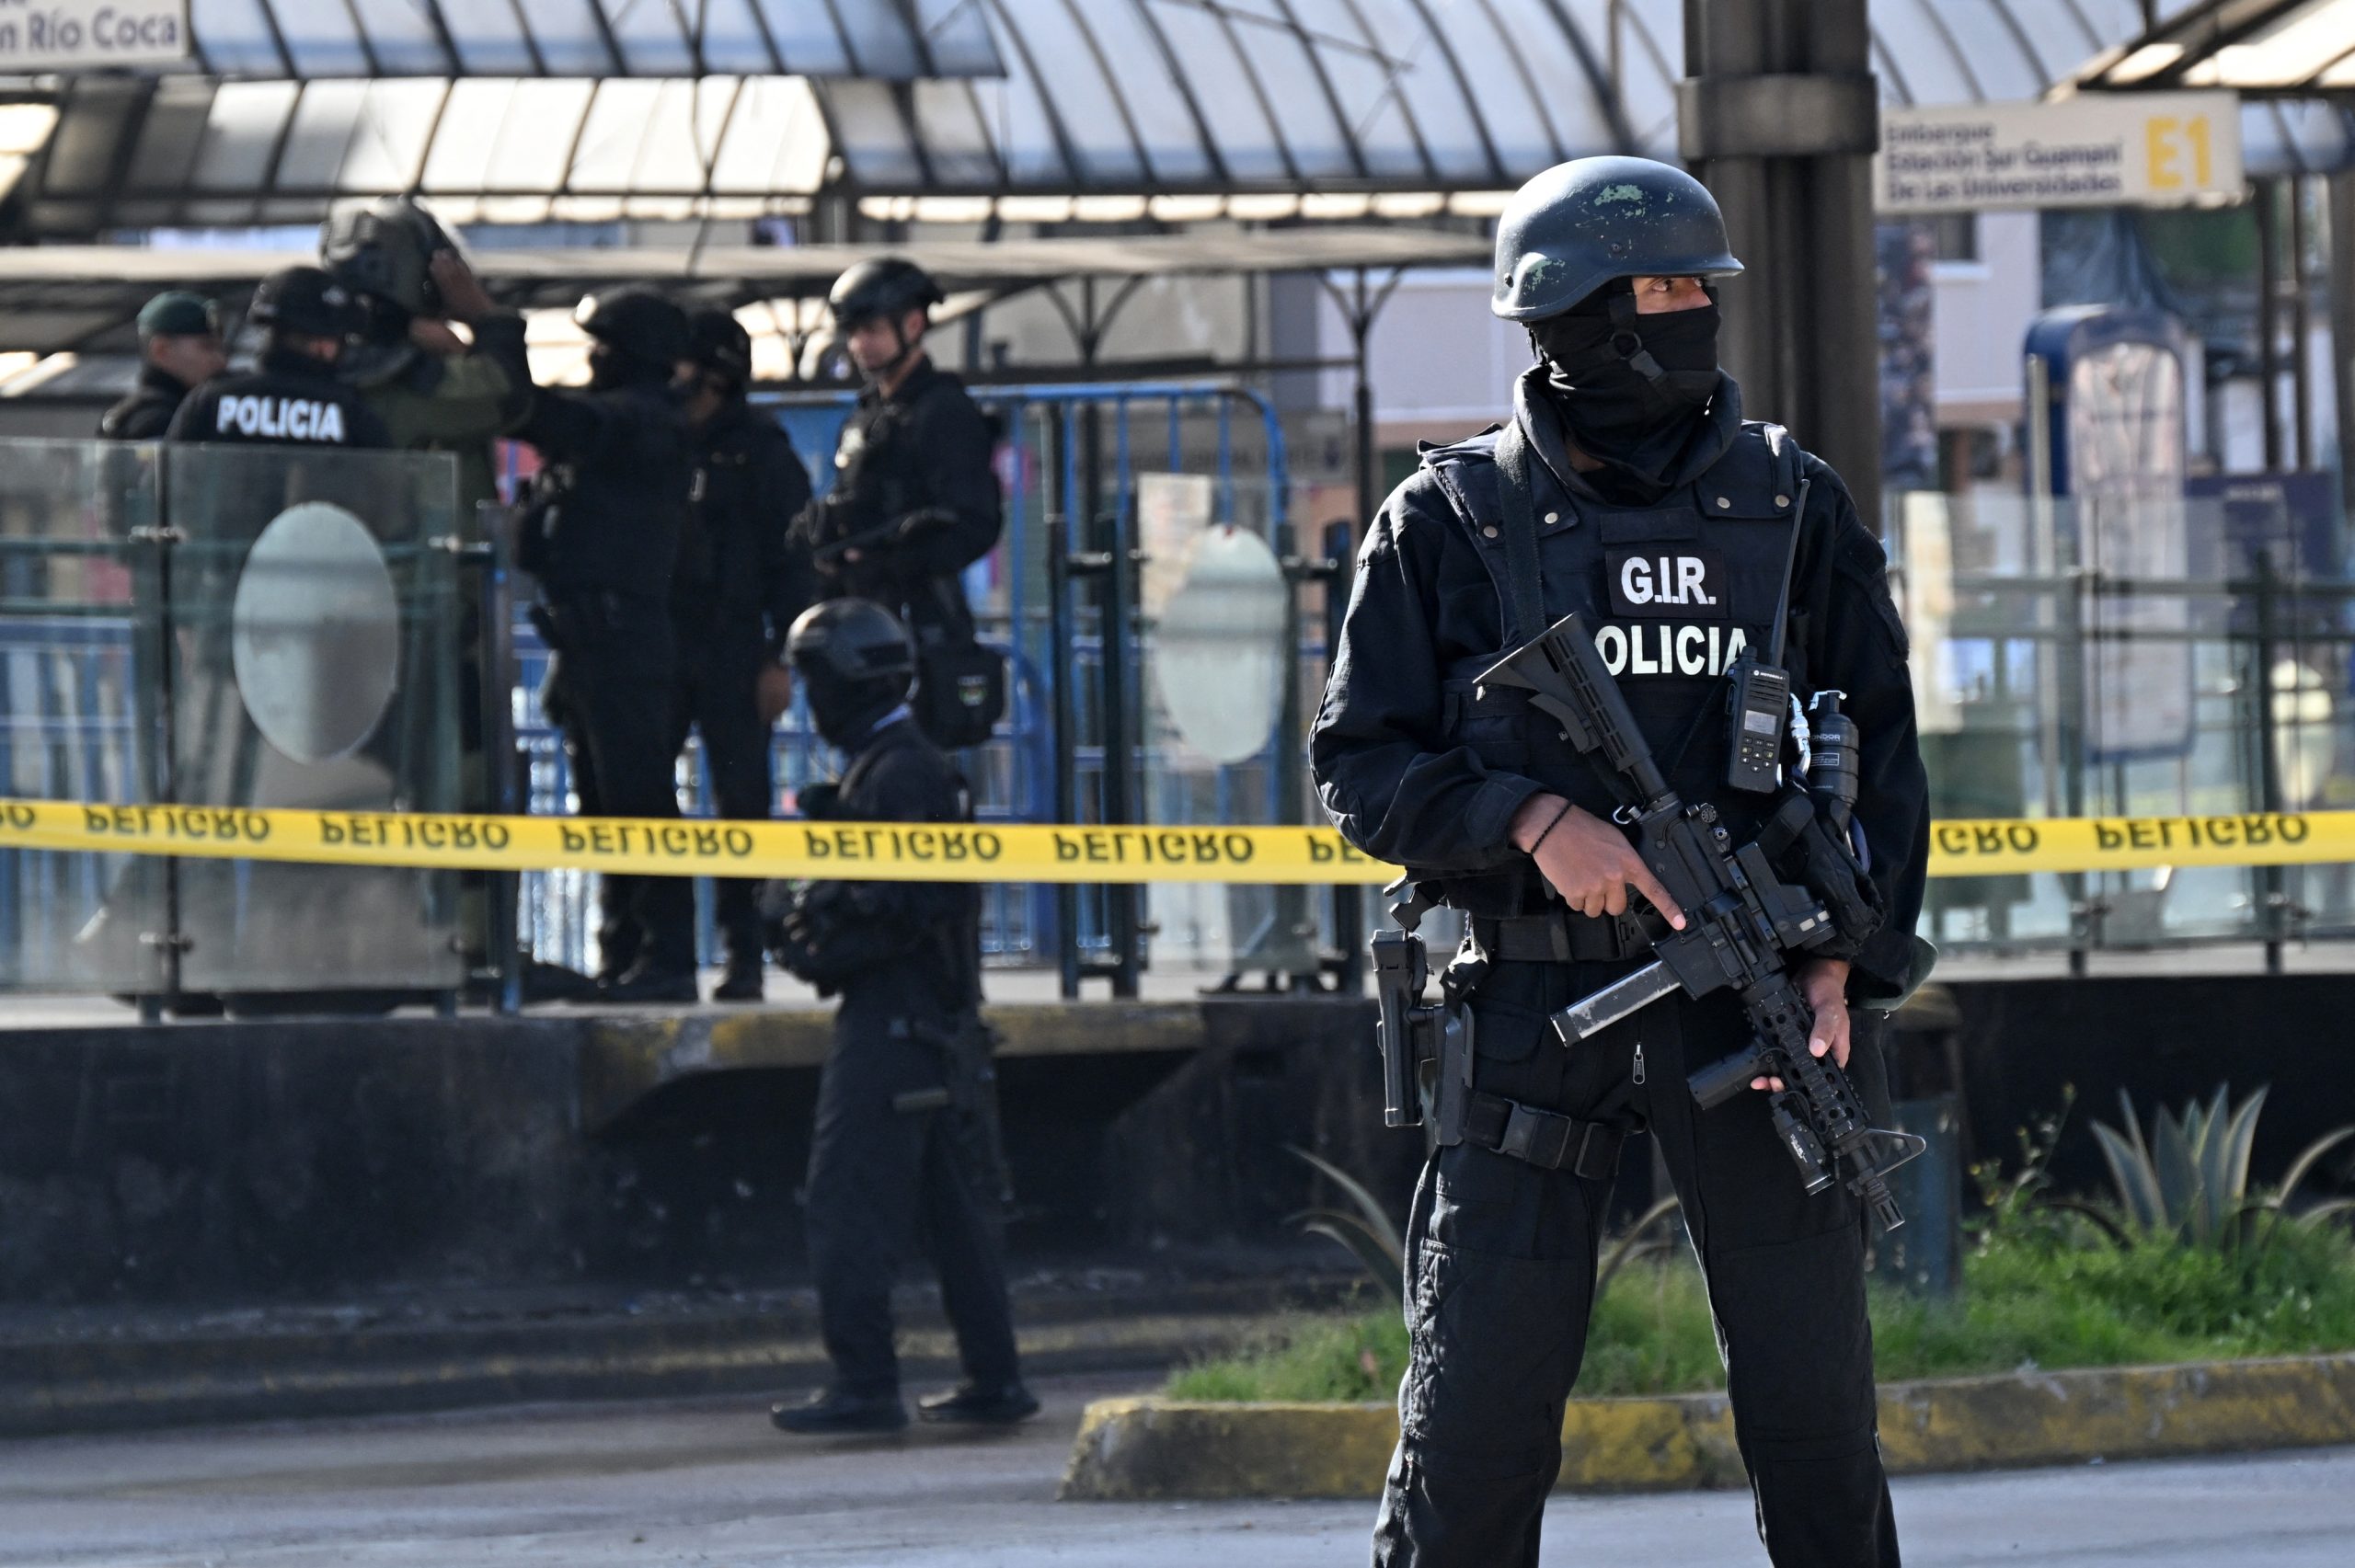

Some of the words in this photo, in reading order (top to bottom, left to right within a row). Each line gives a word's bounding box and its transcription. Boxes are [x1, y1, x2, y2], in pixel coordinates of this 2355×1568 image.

[0, 22, 17, 49] n
[28, 7, 81, 49] Río
[91, 6, 178, 48] Coca
[2145, 116, 2211, 189] E1
[216, 395, 345, 442] POLICIA
[1621, 556, 1717, 604] G.I.R.
[1595, 625, 1748, 676] OLICIA
